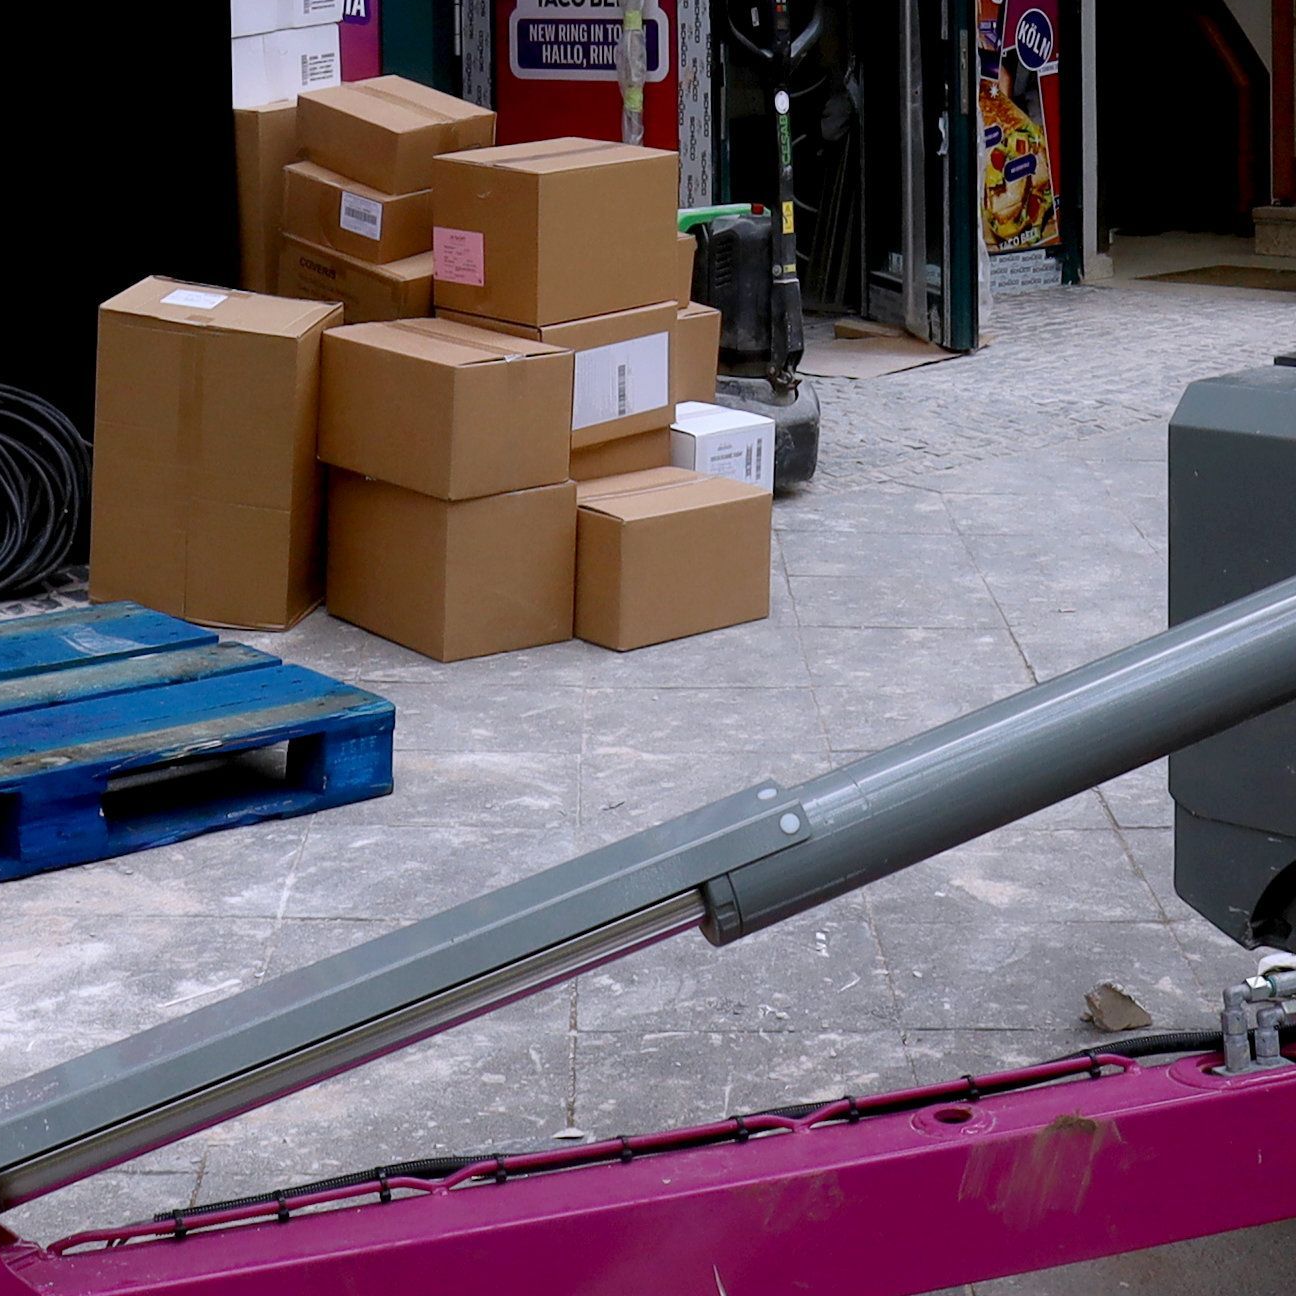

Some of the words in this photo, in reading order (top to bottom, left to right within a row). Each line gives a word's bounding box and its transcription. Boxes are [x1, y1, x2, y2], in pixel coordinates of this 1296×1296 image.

[529, 24, 556, 42] NEW
[559, 25, 587, 42] RING
[591, 25, 603, 42] IN
[1018, 21, 1051, 58] KÖLN
[542, 44, 587, 68] HALLO,
[299, 258, 336, 279] COVERIS
